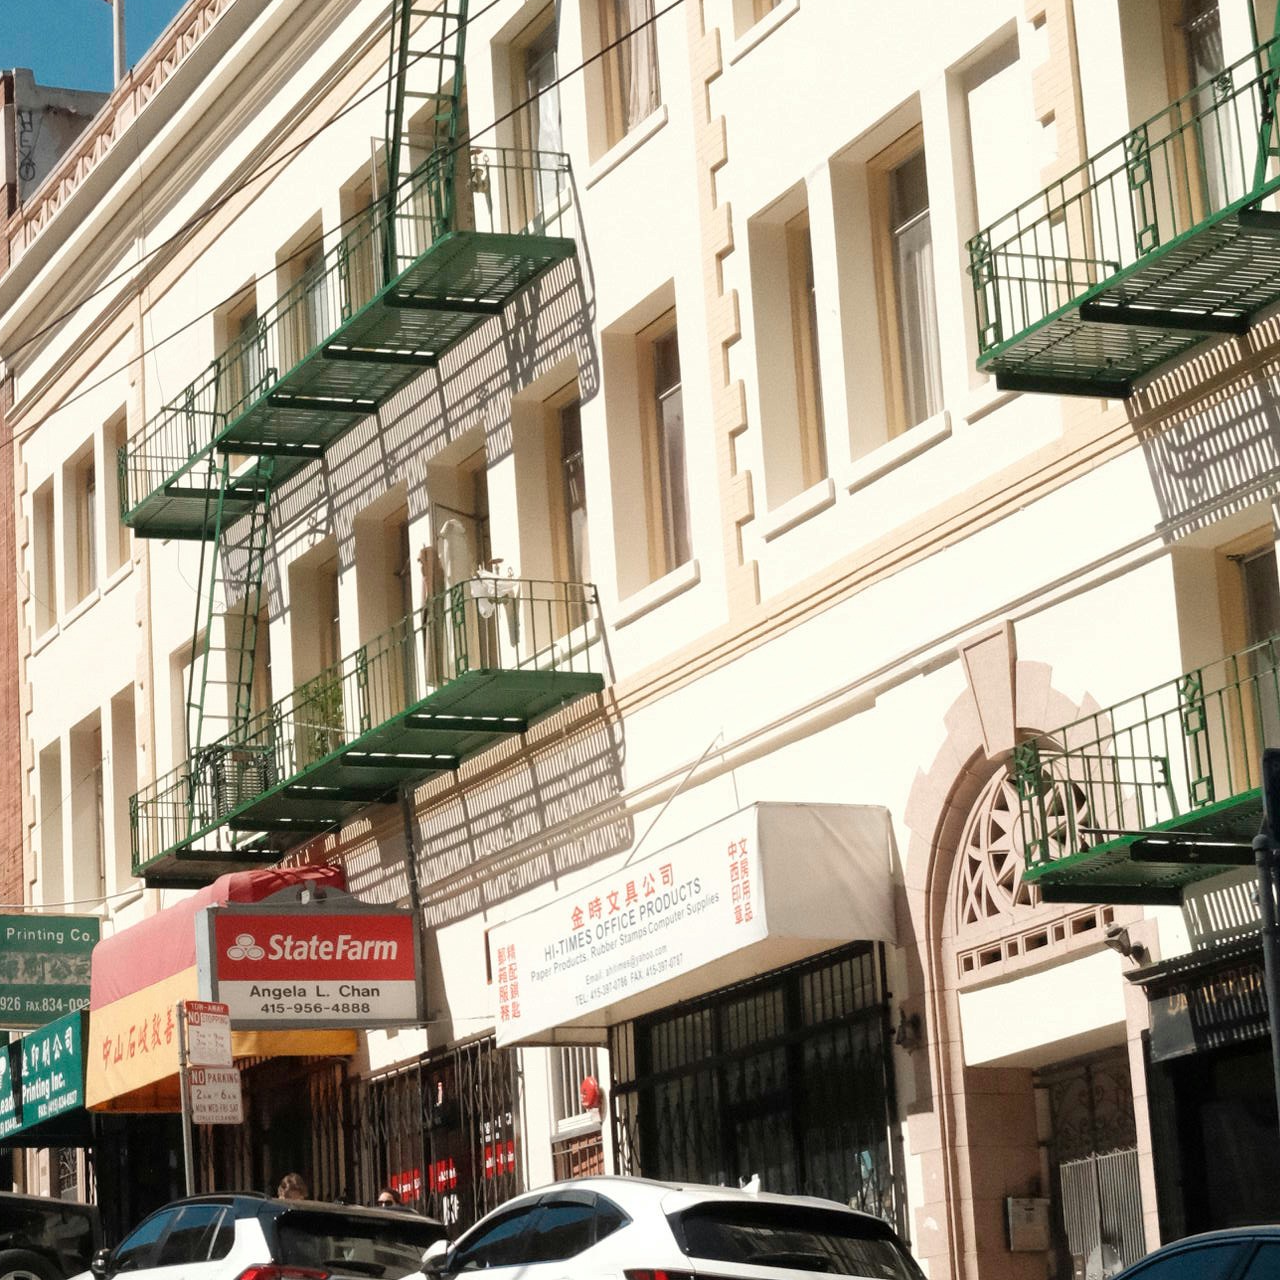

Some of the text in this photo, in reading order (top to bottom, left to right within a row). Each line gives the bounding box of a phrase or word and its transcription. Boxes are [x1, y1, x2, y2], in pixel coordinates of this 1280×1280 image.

[570, 862, 676, 931] 金時文具公司
[544, 877, 701, 962] HI-TIMES OFFICE PRODUCTS
[7, 927, 64, 944] Printing
[71, 928, 95, 942] Co.
[531, 966, 552, 982] Paper
[591, 938, 618, 958] Rubber
[620, 926, 647, 946] Stamps
[648, 910, 685, 934] Computer
[686, 892, 719, 917] Supplies
[249, 985, 380, 1000] Angela L. Chan
[261, 1003, 371, 1014] 415-956-4888
[189, 1012, 200, 1024] NO
[191, 1070, 238, 1084] NO PARKING
[22, 1077, 50, 1104] Printing
[51, 1071, 66, 1092] Inc.
